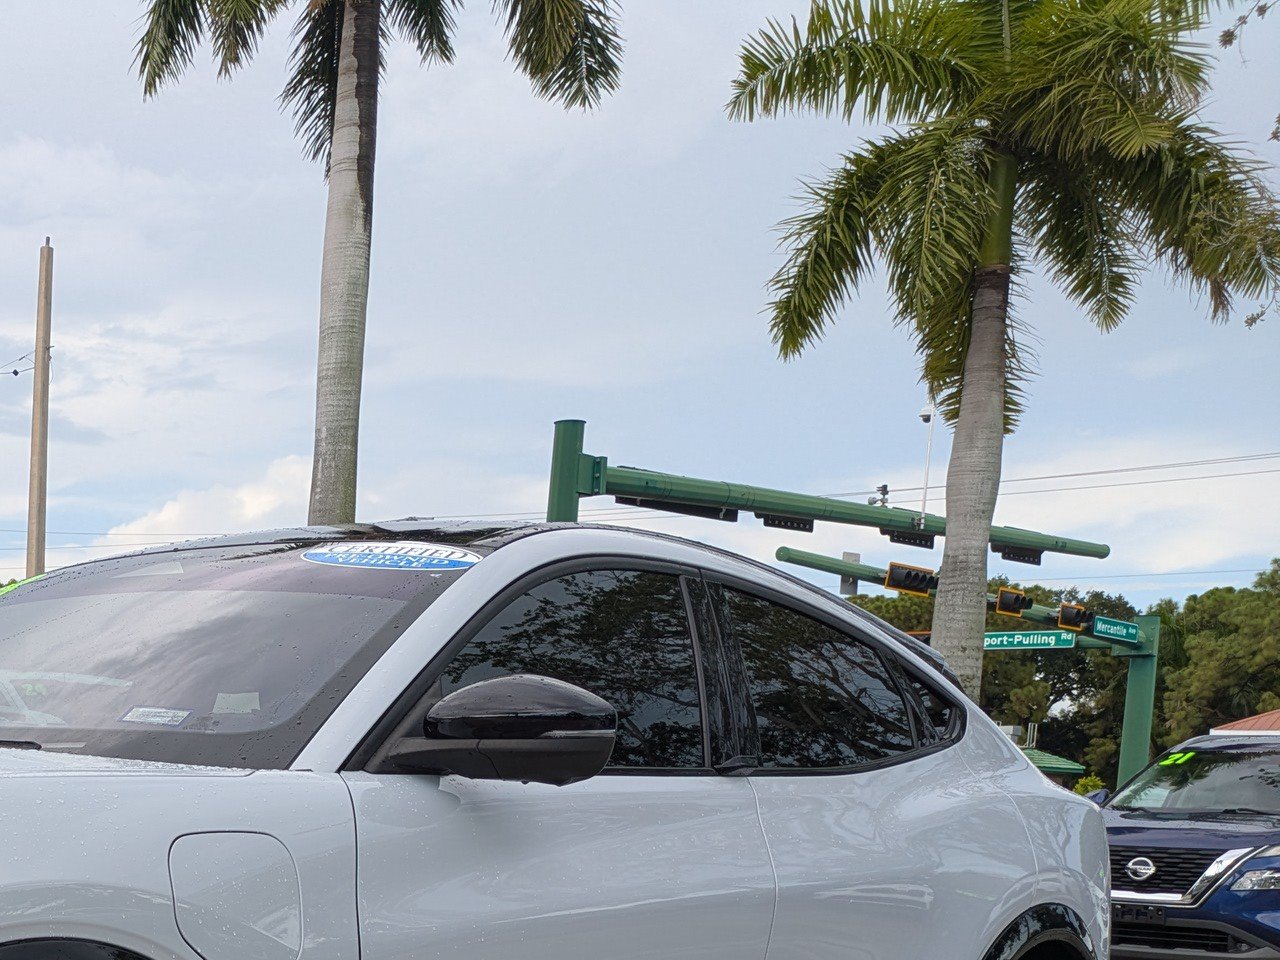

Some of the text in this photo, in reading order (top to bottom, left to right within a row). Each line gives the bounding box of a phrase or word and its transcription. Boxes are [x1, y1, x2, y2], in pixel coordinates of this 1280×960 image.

[325, 552, 449, 566] PRE-OWNED
[328, 545, 469, 560] CERTIFIED
[337, 557, 423, 568] VEHICLE
[1096, 620, 1138, 637] Mercantile Ave
[1061, 632, 1072, 641] Rd
[1158, 751, 1196, 766] 21
